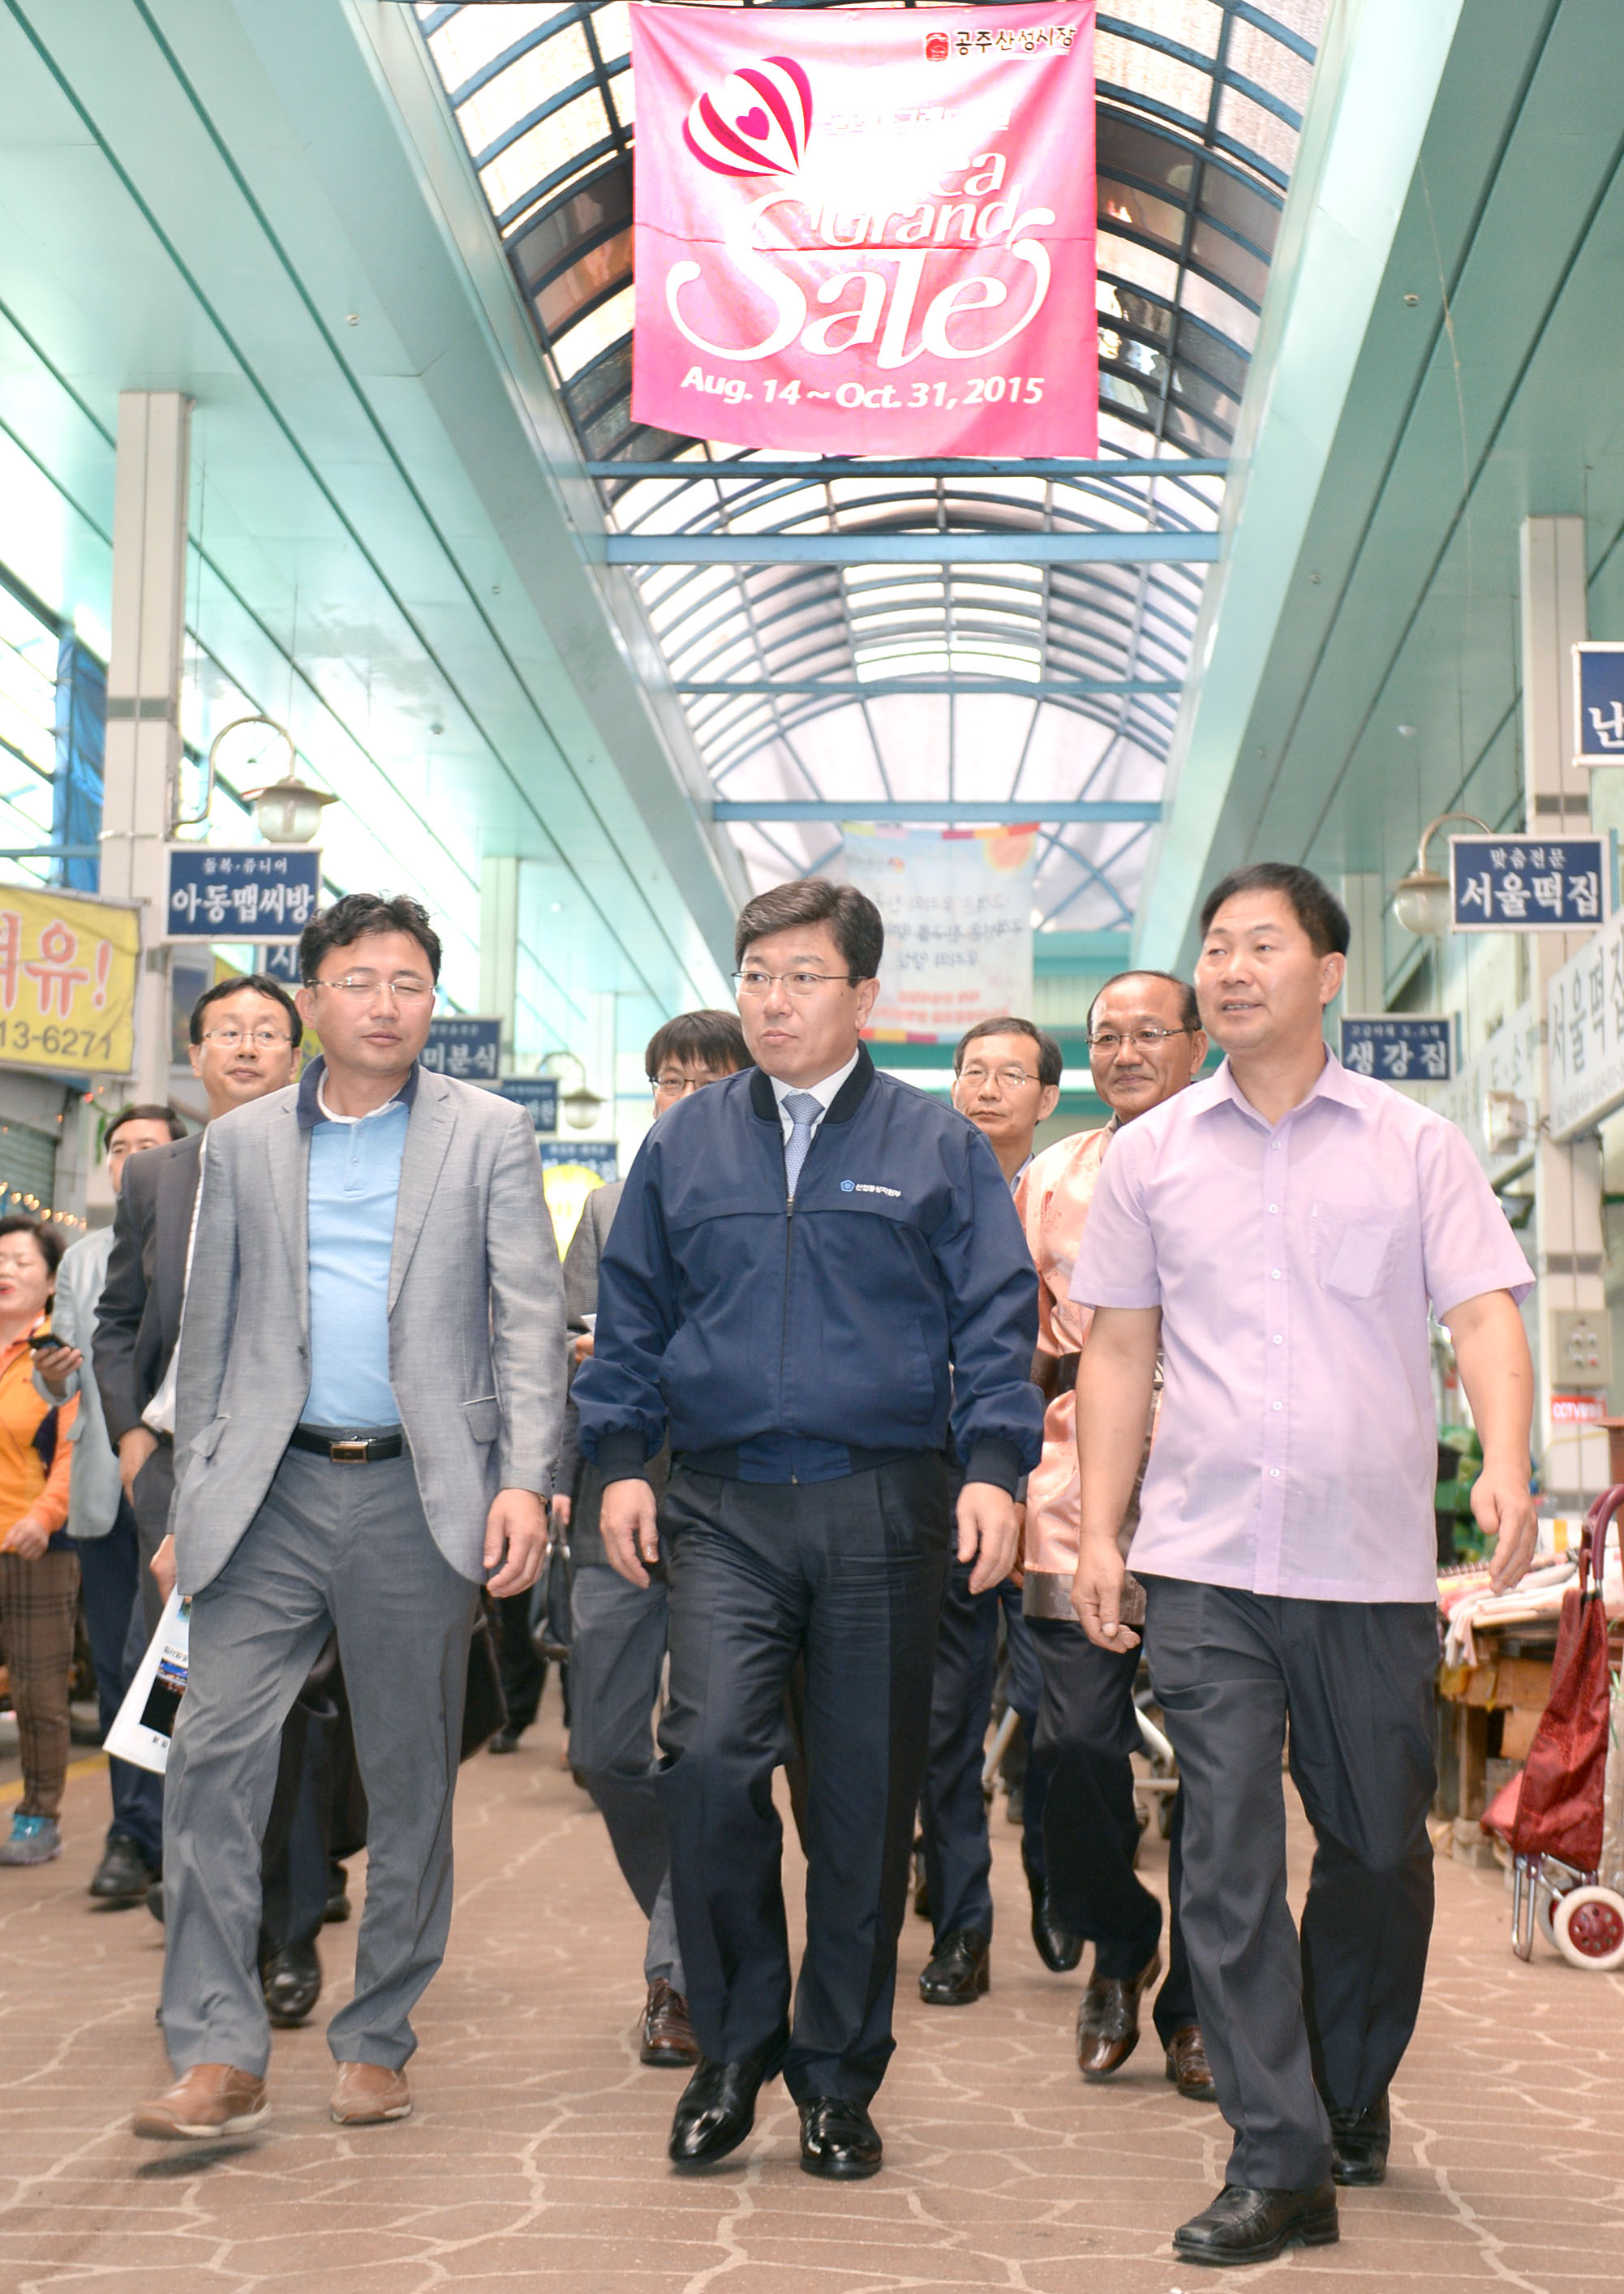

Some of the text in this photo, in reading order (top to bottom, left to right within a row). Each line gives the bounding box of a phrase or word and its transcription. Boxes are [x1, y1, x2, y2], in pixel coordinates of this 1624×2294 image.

[956, 27, 1077, 56] 공주산성시장
[665, 191, 1055, 369] Sale
[681, 366, 753, 404] Aug.
[908, 382, 957, 410] 31,
[963, 376, 1045, 405] 2015
[1461, 871, 1599, 919] 서울떡집
